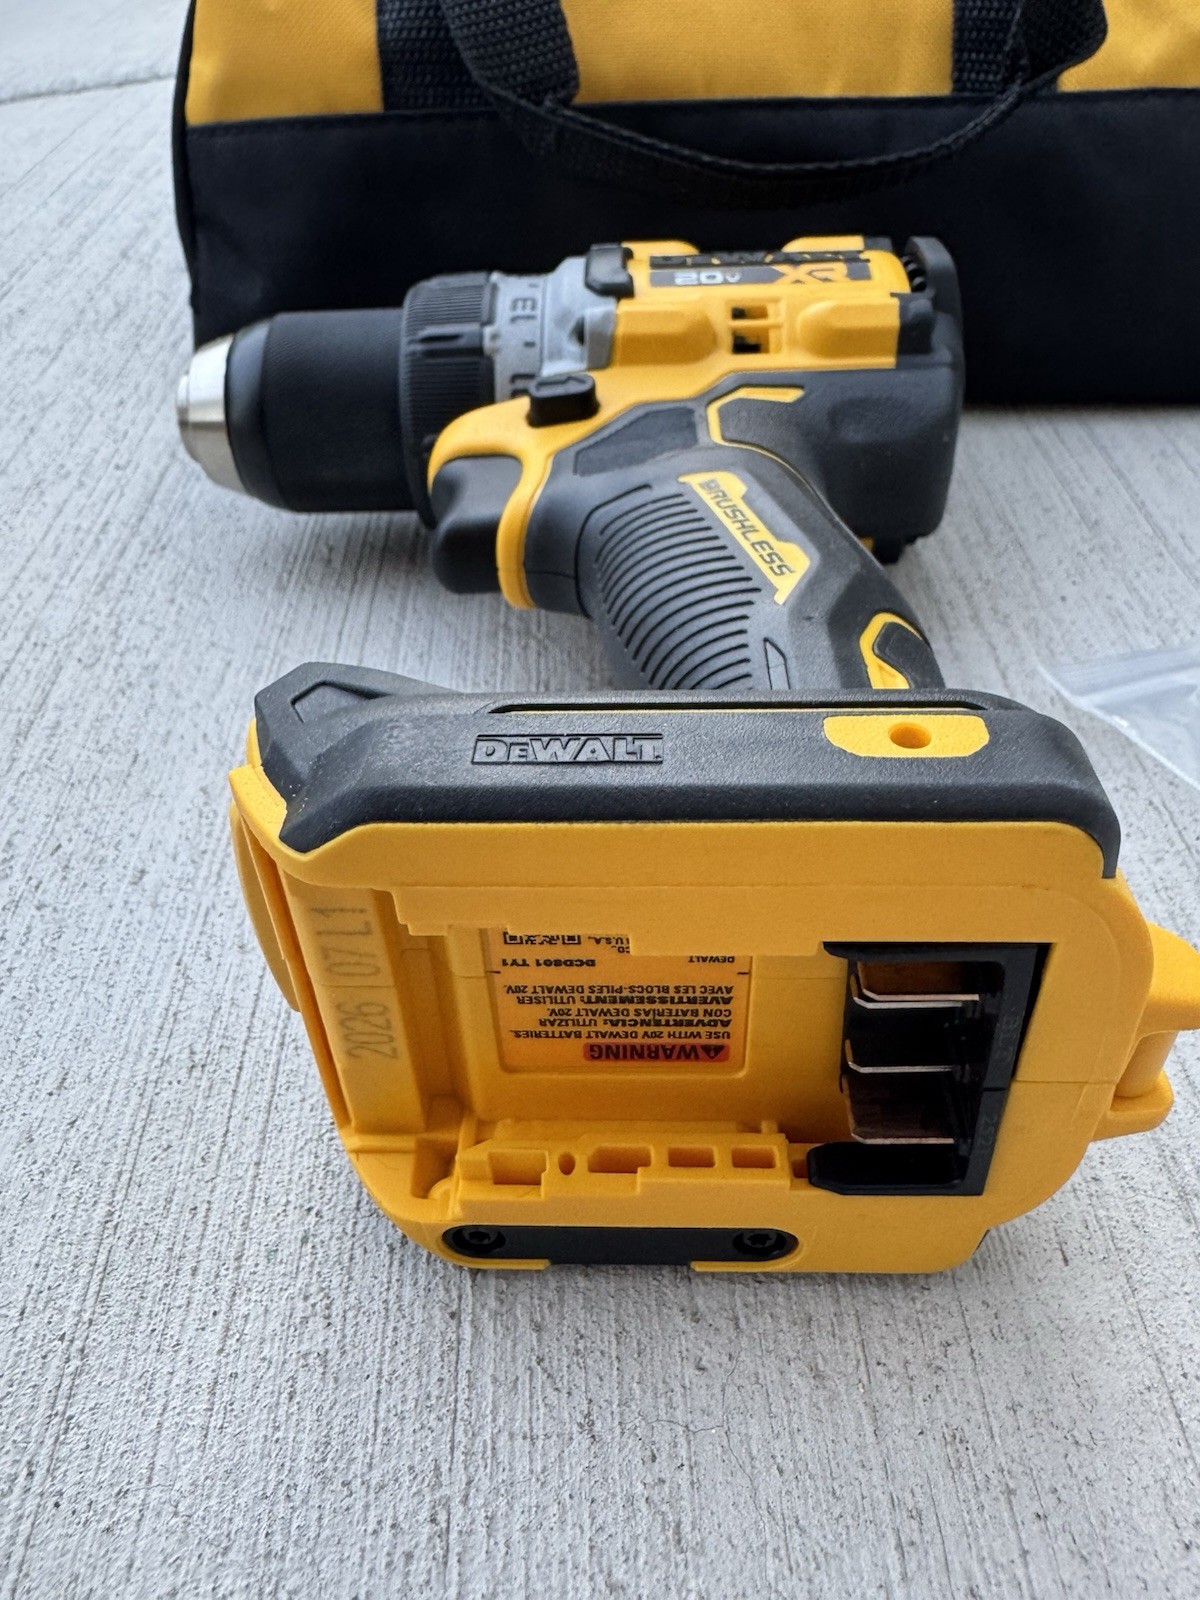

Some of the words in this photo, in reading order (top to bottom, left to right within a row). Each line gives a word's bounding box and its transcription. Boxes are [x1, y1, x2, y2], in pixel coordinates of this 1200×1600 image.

[771, 261, 848, 286] XR
[698, 478, 796, 577] BRUSHLESS
[471, 733, 663, 765] DEWALT
[501, 958, 530, 968] TY1
[687, 955, 736, 964] DEWALT
[504, 984, 528, 994] 20V.
[531, 984, 584, 994] DEWALT
[588, 984, 670, 994] BLOCS-PILES
[674, 985, 696, 994] LES
[700, 985, 734, 994] AVEC
[516, 995, 576, 1005] UTILISER
[580, 995, 733, 1005] AVERTISSEMENT:
[547, 1007, 572, 1017] 20V.
[575, 1007, 630, 1017] DEWALT
[702, 1008, 732, 1017] CON
[538, 1018, 598, 1027] UTILIZAR
[602, 1018, 732, 1028] ADVERTENCIA:
[510, 1029, 582, 1039] BATTERIES.
[586, 1030, 638, 1039] DEWALT
[641, 1030, 664, 1039] 20V
[667, 1030, 702, 1039] WITH
[705, 1030, 731, 1039] USE
[589, 1044, 701, 1060] WARNING
